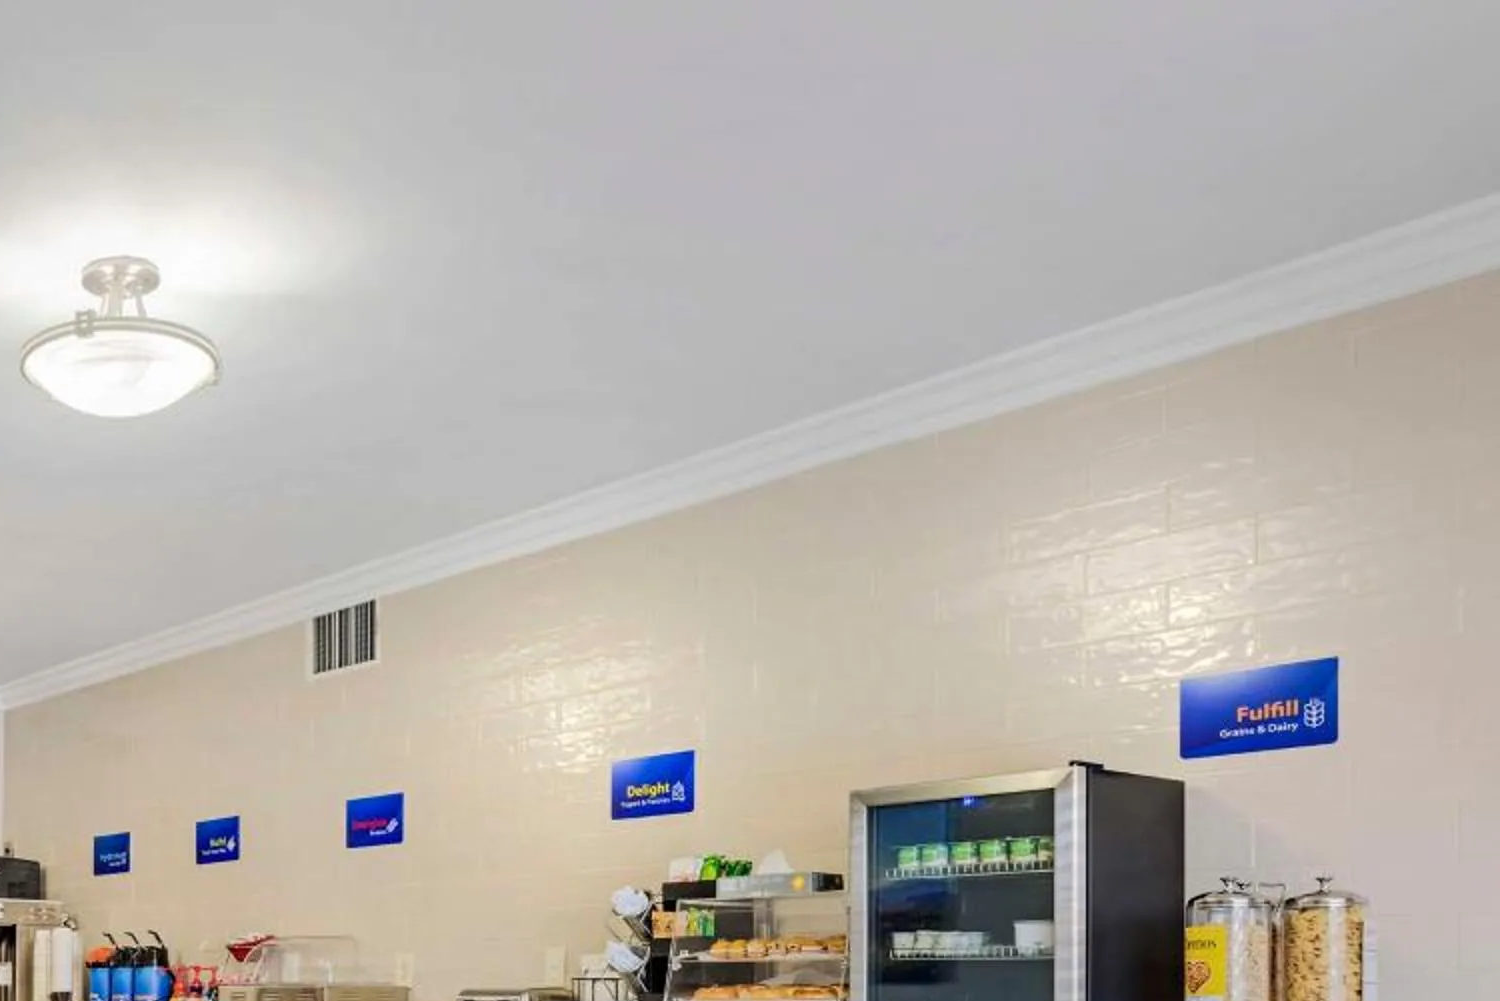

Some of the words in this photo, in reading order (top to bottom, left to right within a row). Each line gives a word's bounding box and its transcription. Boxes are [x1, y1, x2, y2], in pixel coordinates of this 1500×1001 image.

[1236, 699, 1299, 723] Fulfill
[1219, 728, 1255, 739] Grains
[1257, 725, 1266, 734] &
[1267, 721, 1299, 733] Dairy
[627, 781, 670, 799] Delight
